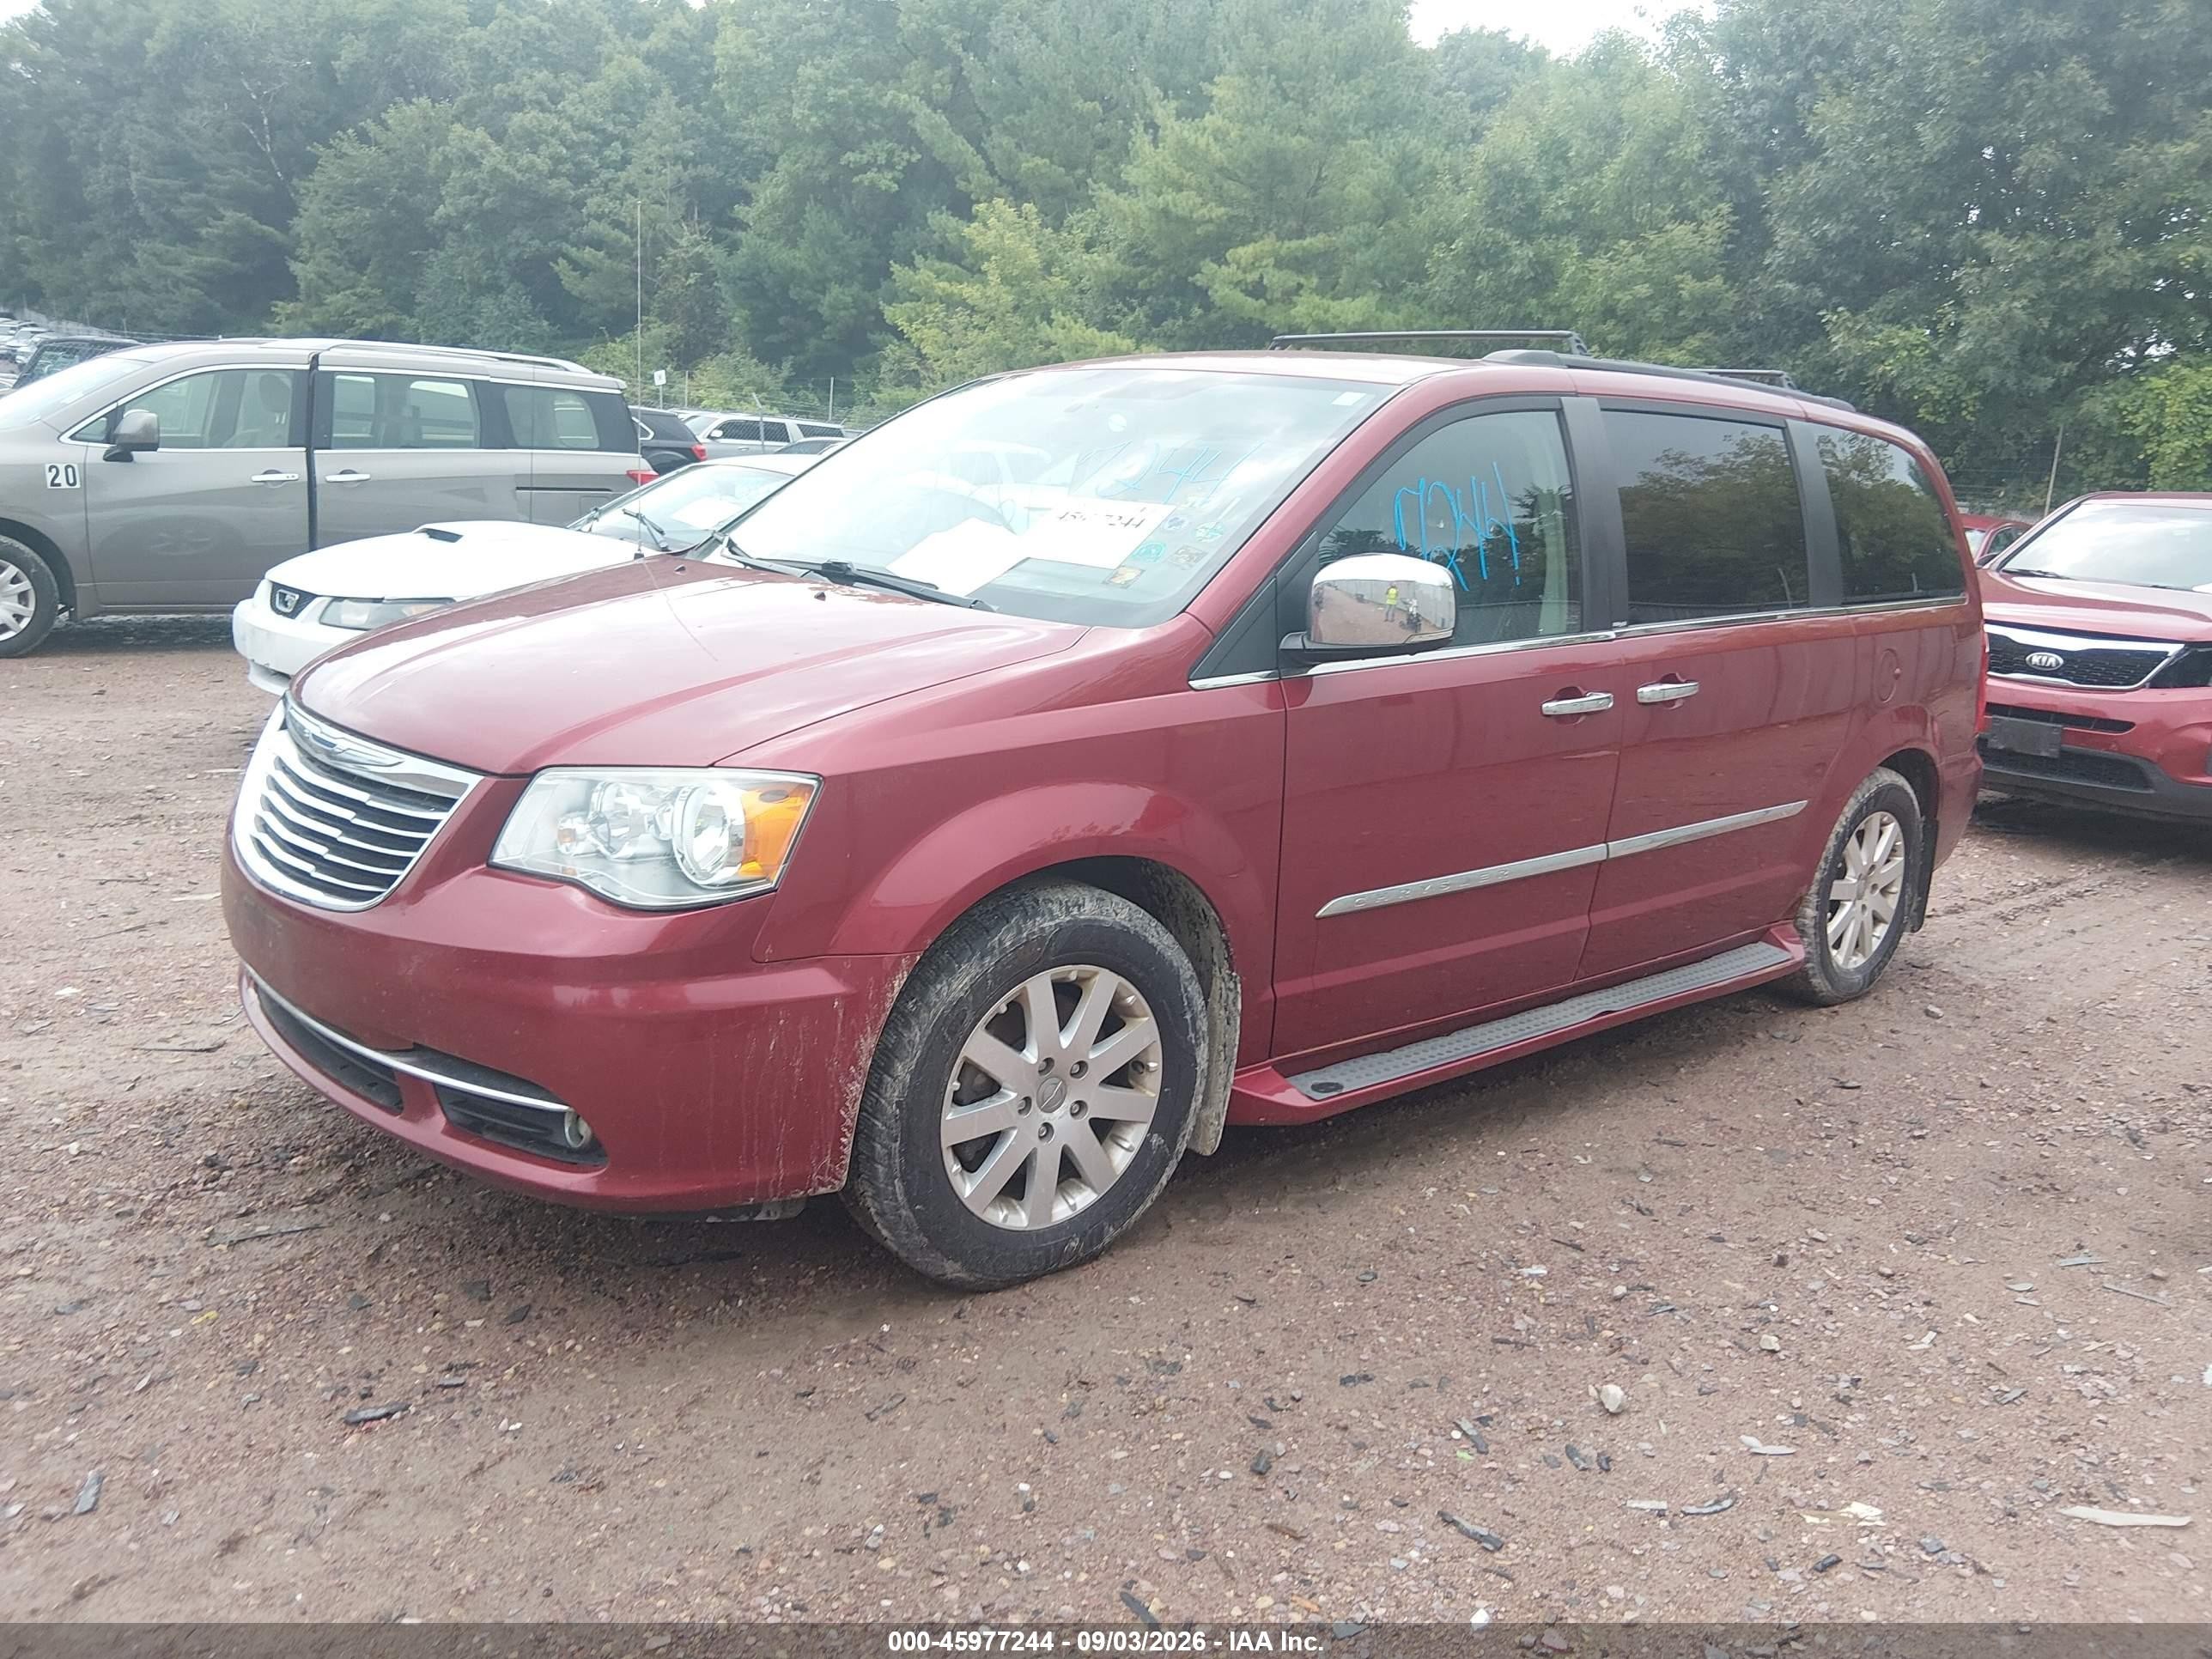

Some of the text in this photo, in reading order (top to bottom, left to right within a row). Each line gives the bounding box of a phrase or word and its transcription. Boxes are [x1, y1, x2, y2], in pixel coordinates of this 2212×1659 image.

[47, 464, 78, 488] 20
[2031, 654, 2057, 667] KIA
[1353, 869, 1510, 908] CHRYSLER
